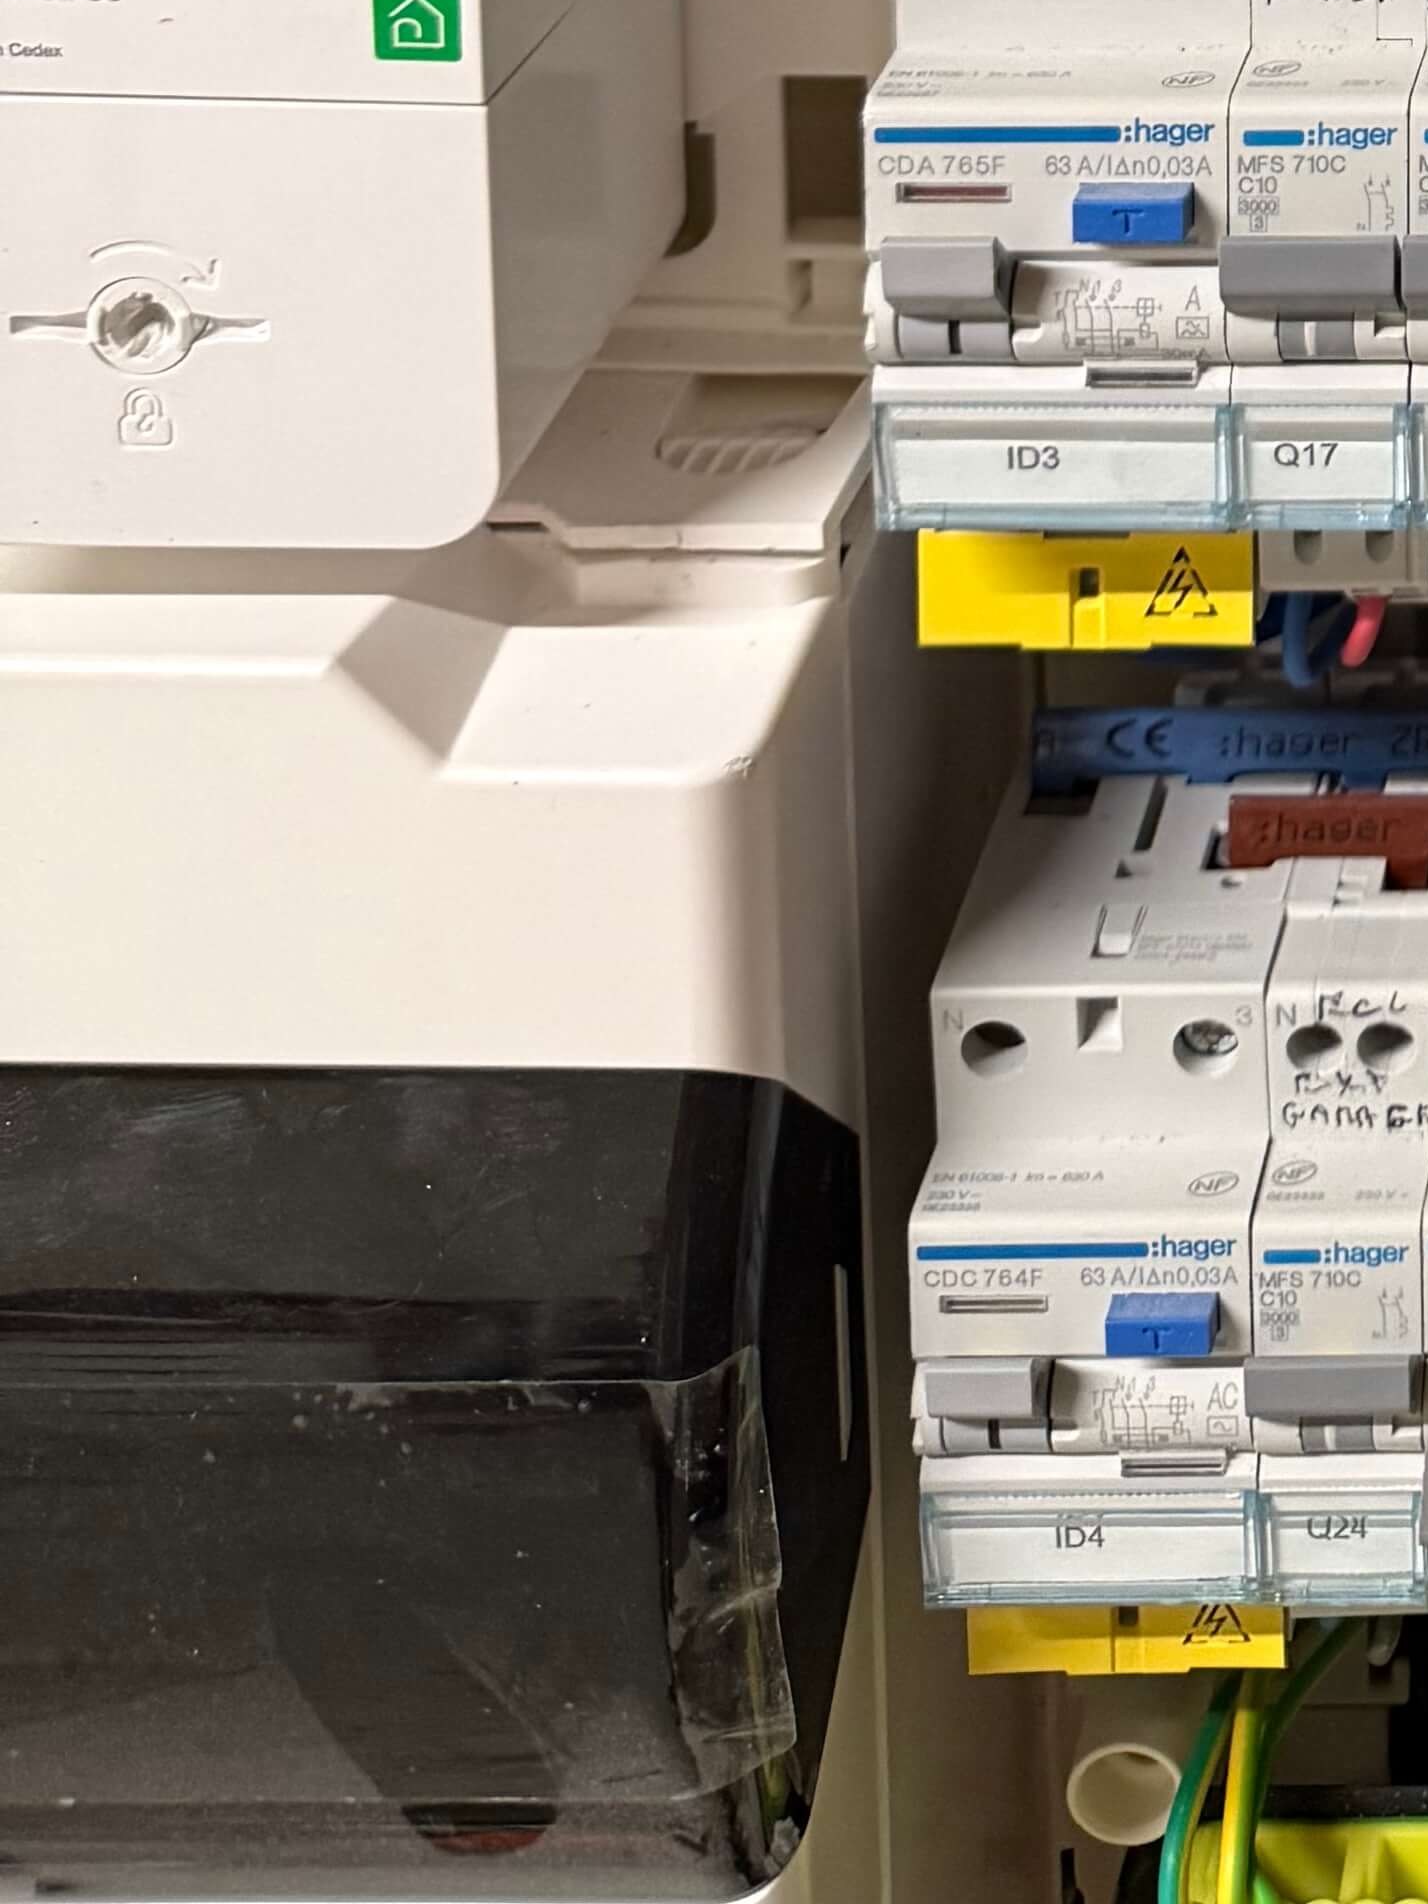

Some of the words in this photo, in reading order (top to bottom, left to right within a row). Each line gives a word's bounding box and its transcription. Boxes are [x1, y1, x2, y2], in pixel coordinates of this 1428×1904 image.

[9, 43, 63, 57] Cedex
[877, 156, 937, 175] CDA
[943, 156, 1006, 175] 765F
[1045, 155, 1073, 175] 63
[1007, 445, 1061, 470] ID3
[1274, 443, 1339, 468] Q17
[1055, 1526, 1105, 1549] ID4
